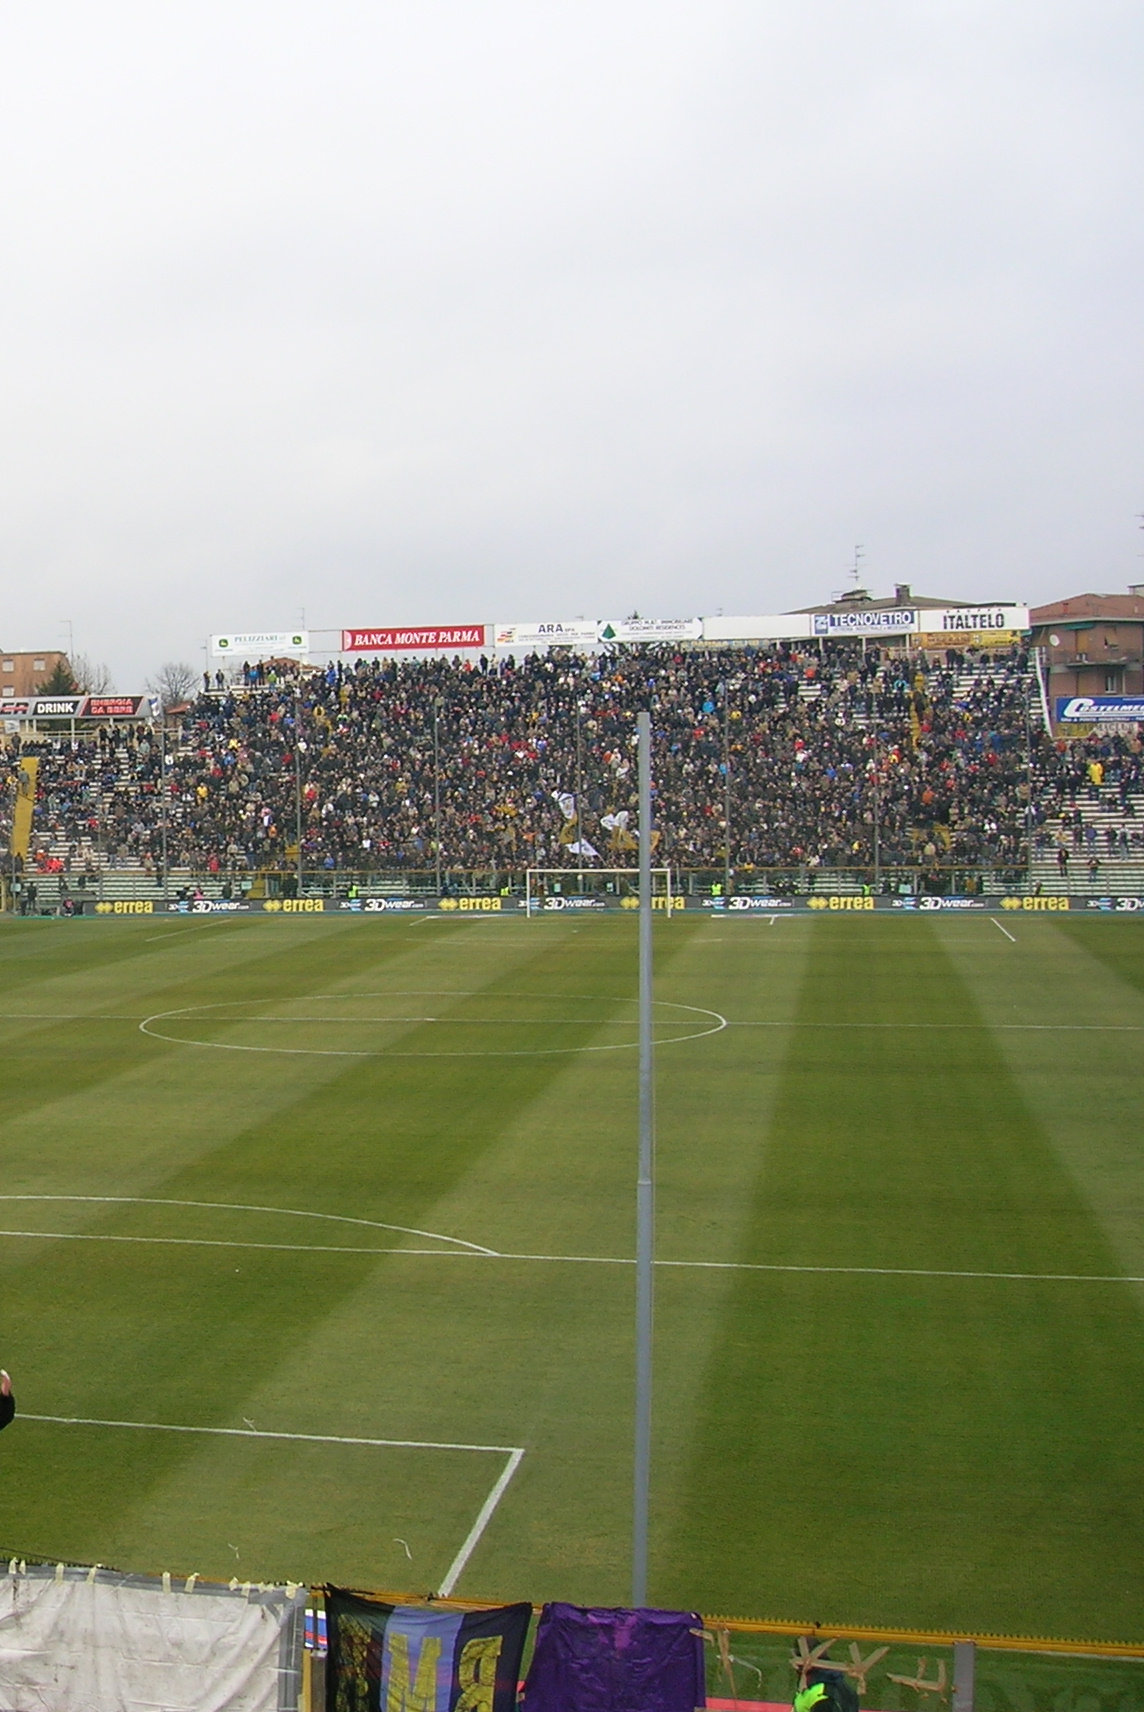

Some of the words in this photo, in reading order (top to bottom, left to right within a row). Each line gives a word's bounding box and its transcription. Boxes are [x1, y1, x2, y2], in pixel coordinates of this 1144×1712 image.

[832, 612, 911, 626] TECNOVETRO
[943, 614, 1004, 629] ITALTELO
[538, 624, 564, 633] ARA
[354, 634, 392, 646] BANCA
[395, 632, 436, 644] MONTE
[438, 630, 480, 643] PARMA
[37, 702, 74, 714] DRINK
[90, 706, 104, 714] DA
[114, 901, 153, 914] errea
[282, 899, 324, 912] errea
[459, 897, 502, 910] errea
[651, 896, 685, 910] rrea
[828, 896, 874, 910] errea
[1022, 896, 1070, 910] errea
